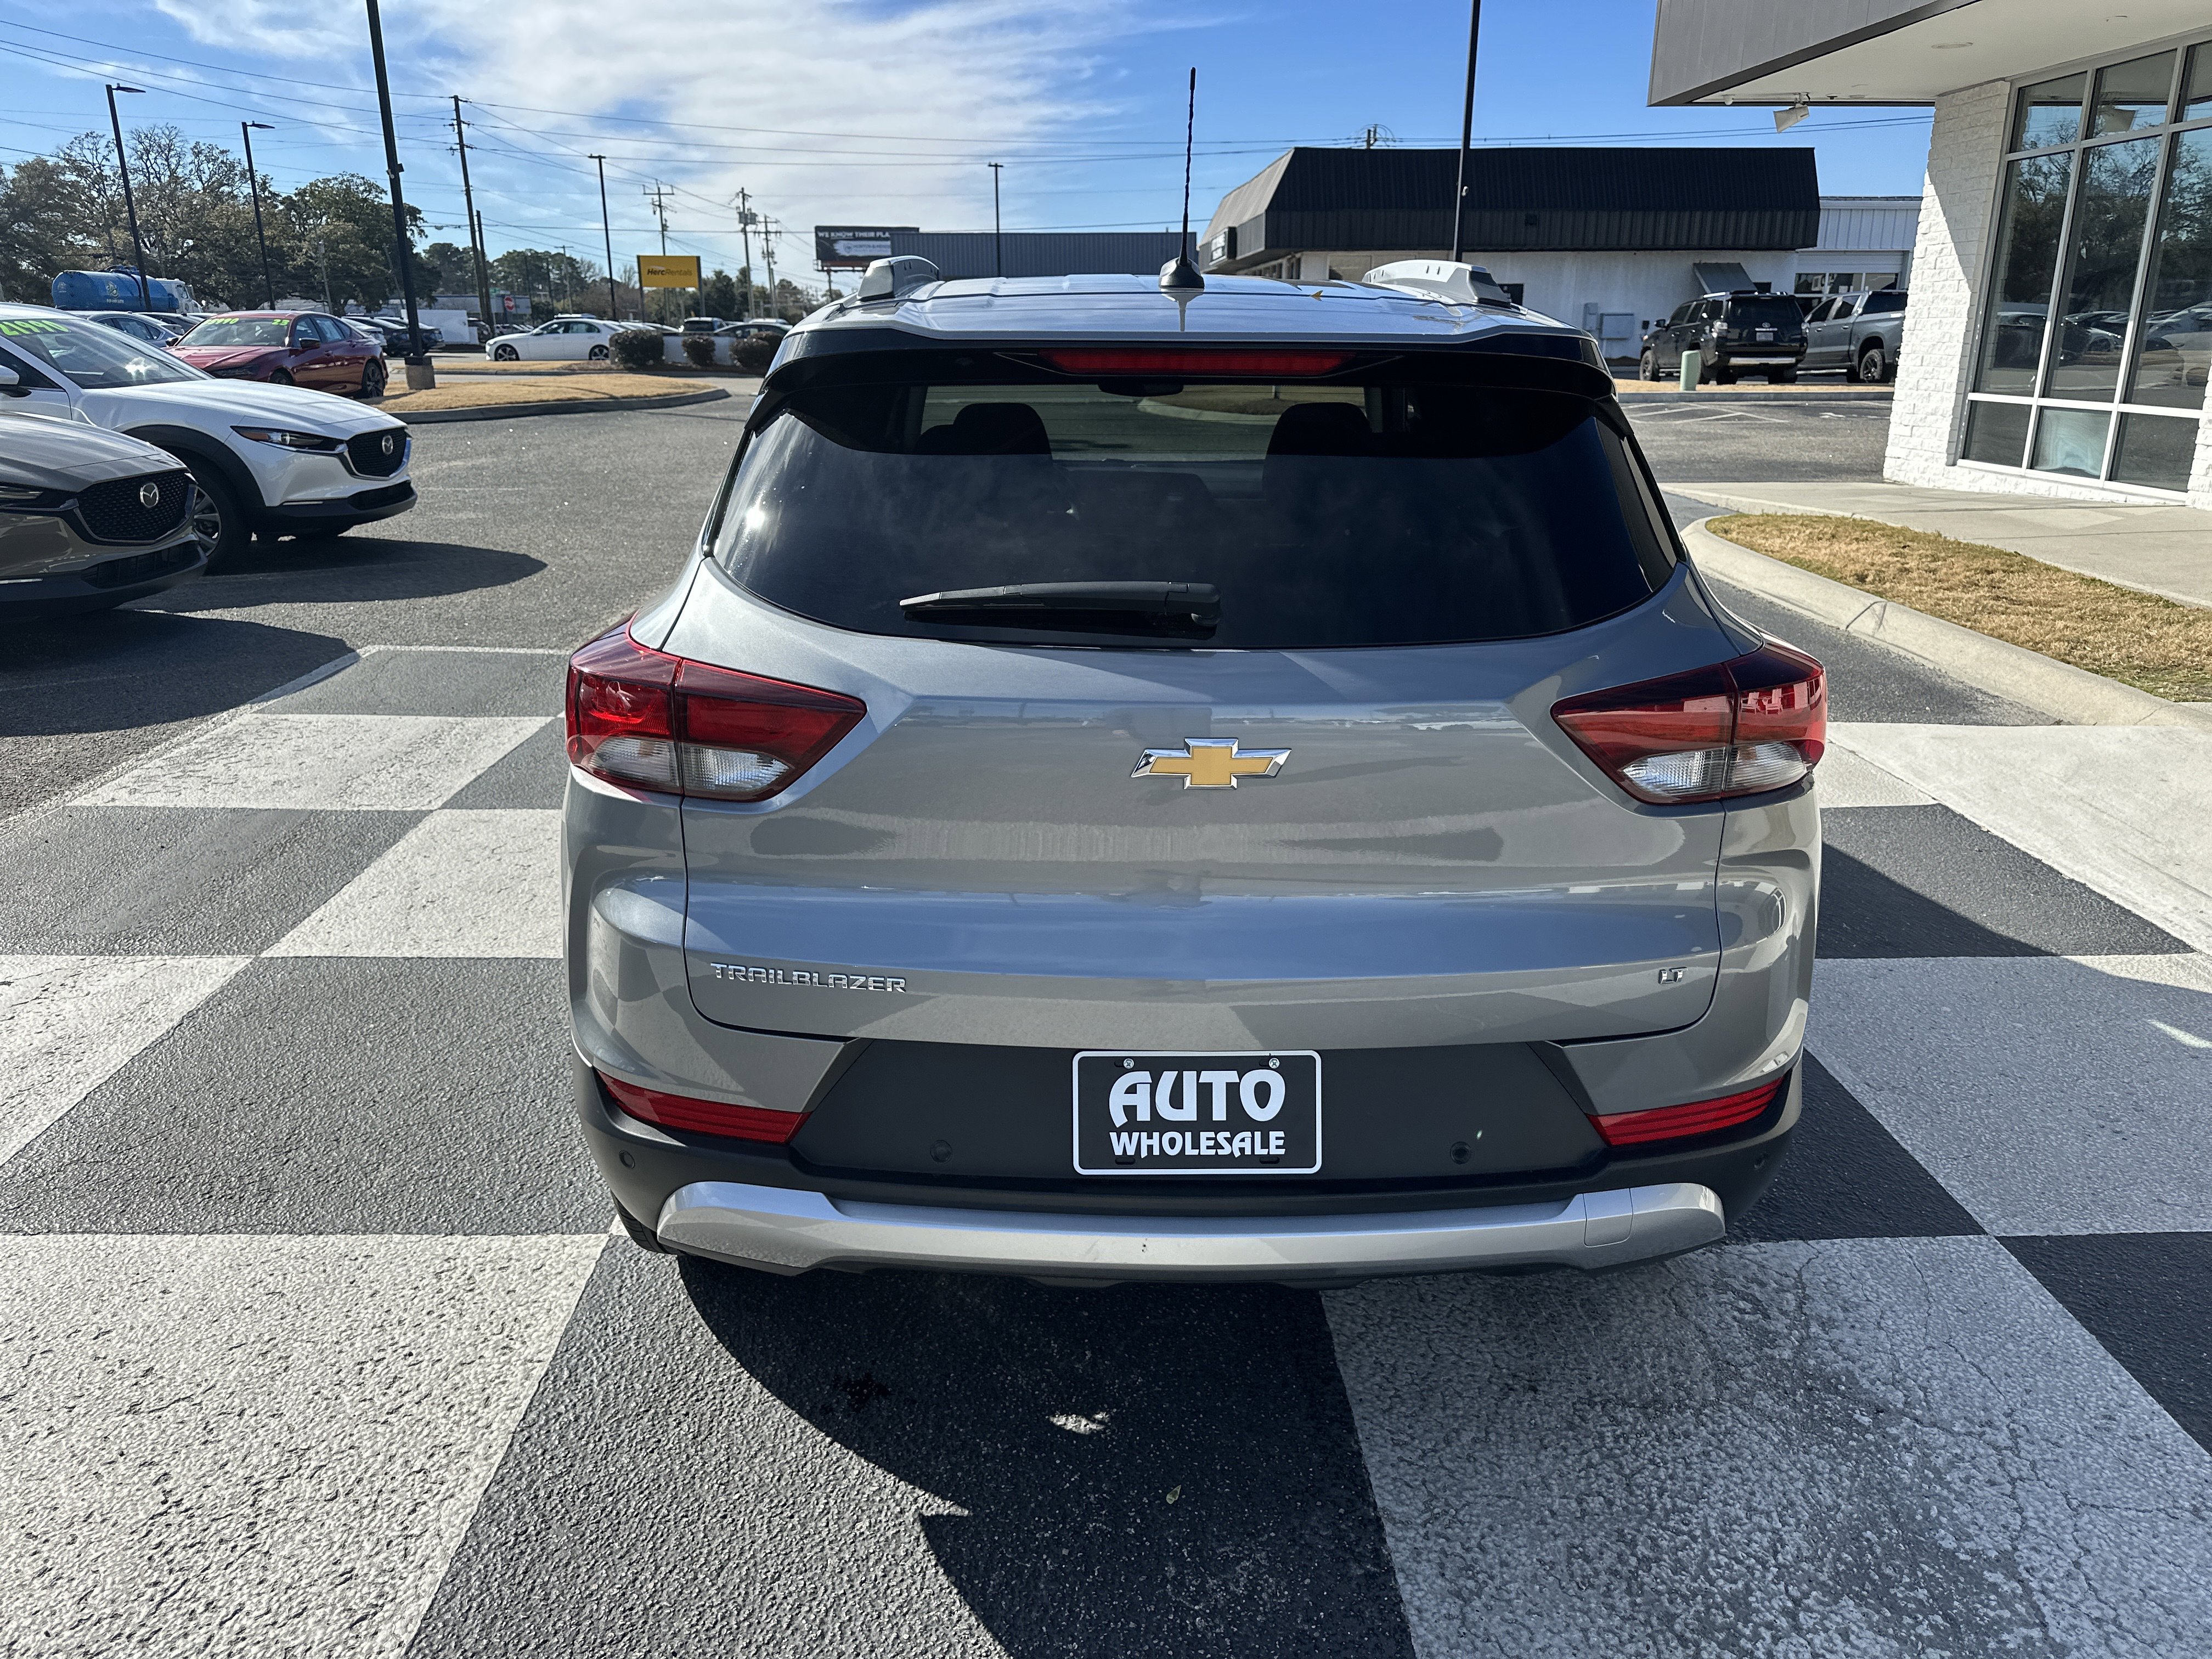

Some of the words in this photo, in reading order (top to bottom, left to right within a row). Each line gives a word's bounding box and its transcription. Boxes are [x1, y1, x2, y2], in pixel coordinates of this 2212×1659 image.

[710, 962, 906, 993] TRAILBLAZER
[1658, 967, 1688, 984] LT
[1109, 1069, 1285, 1128] AUTO
[1109, 1131, 1285, 1158] WHOLESALE
